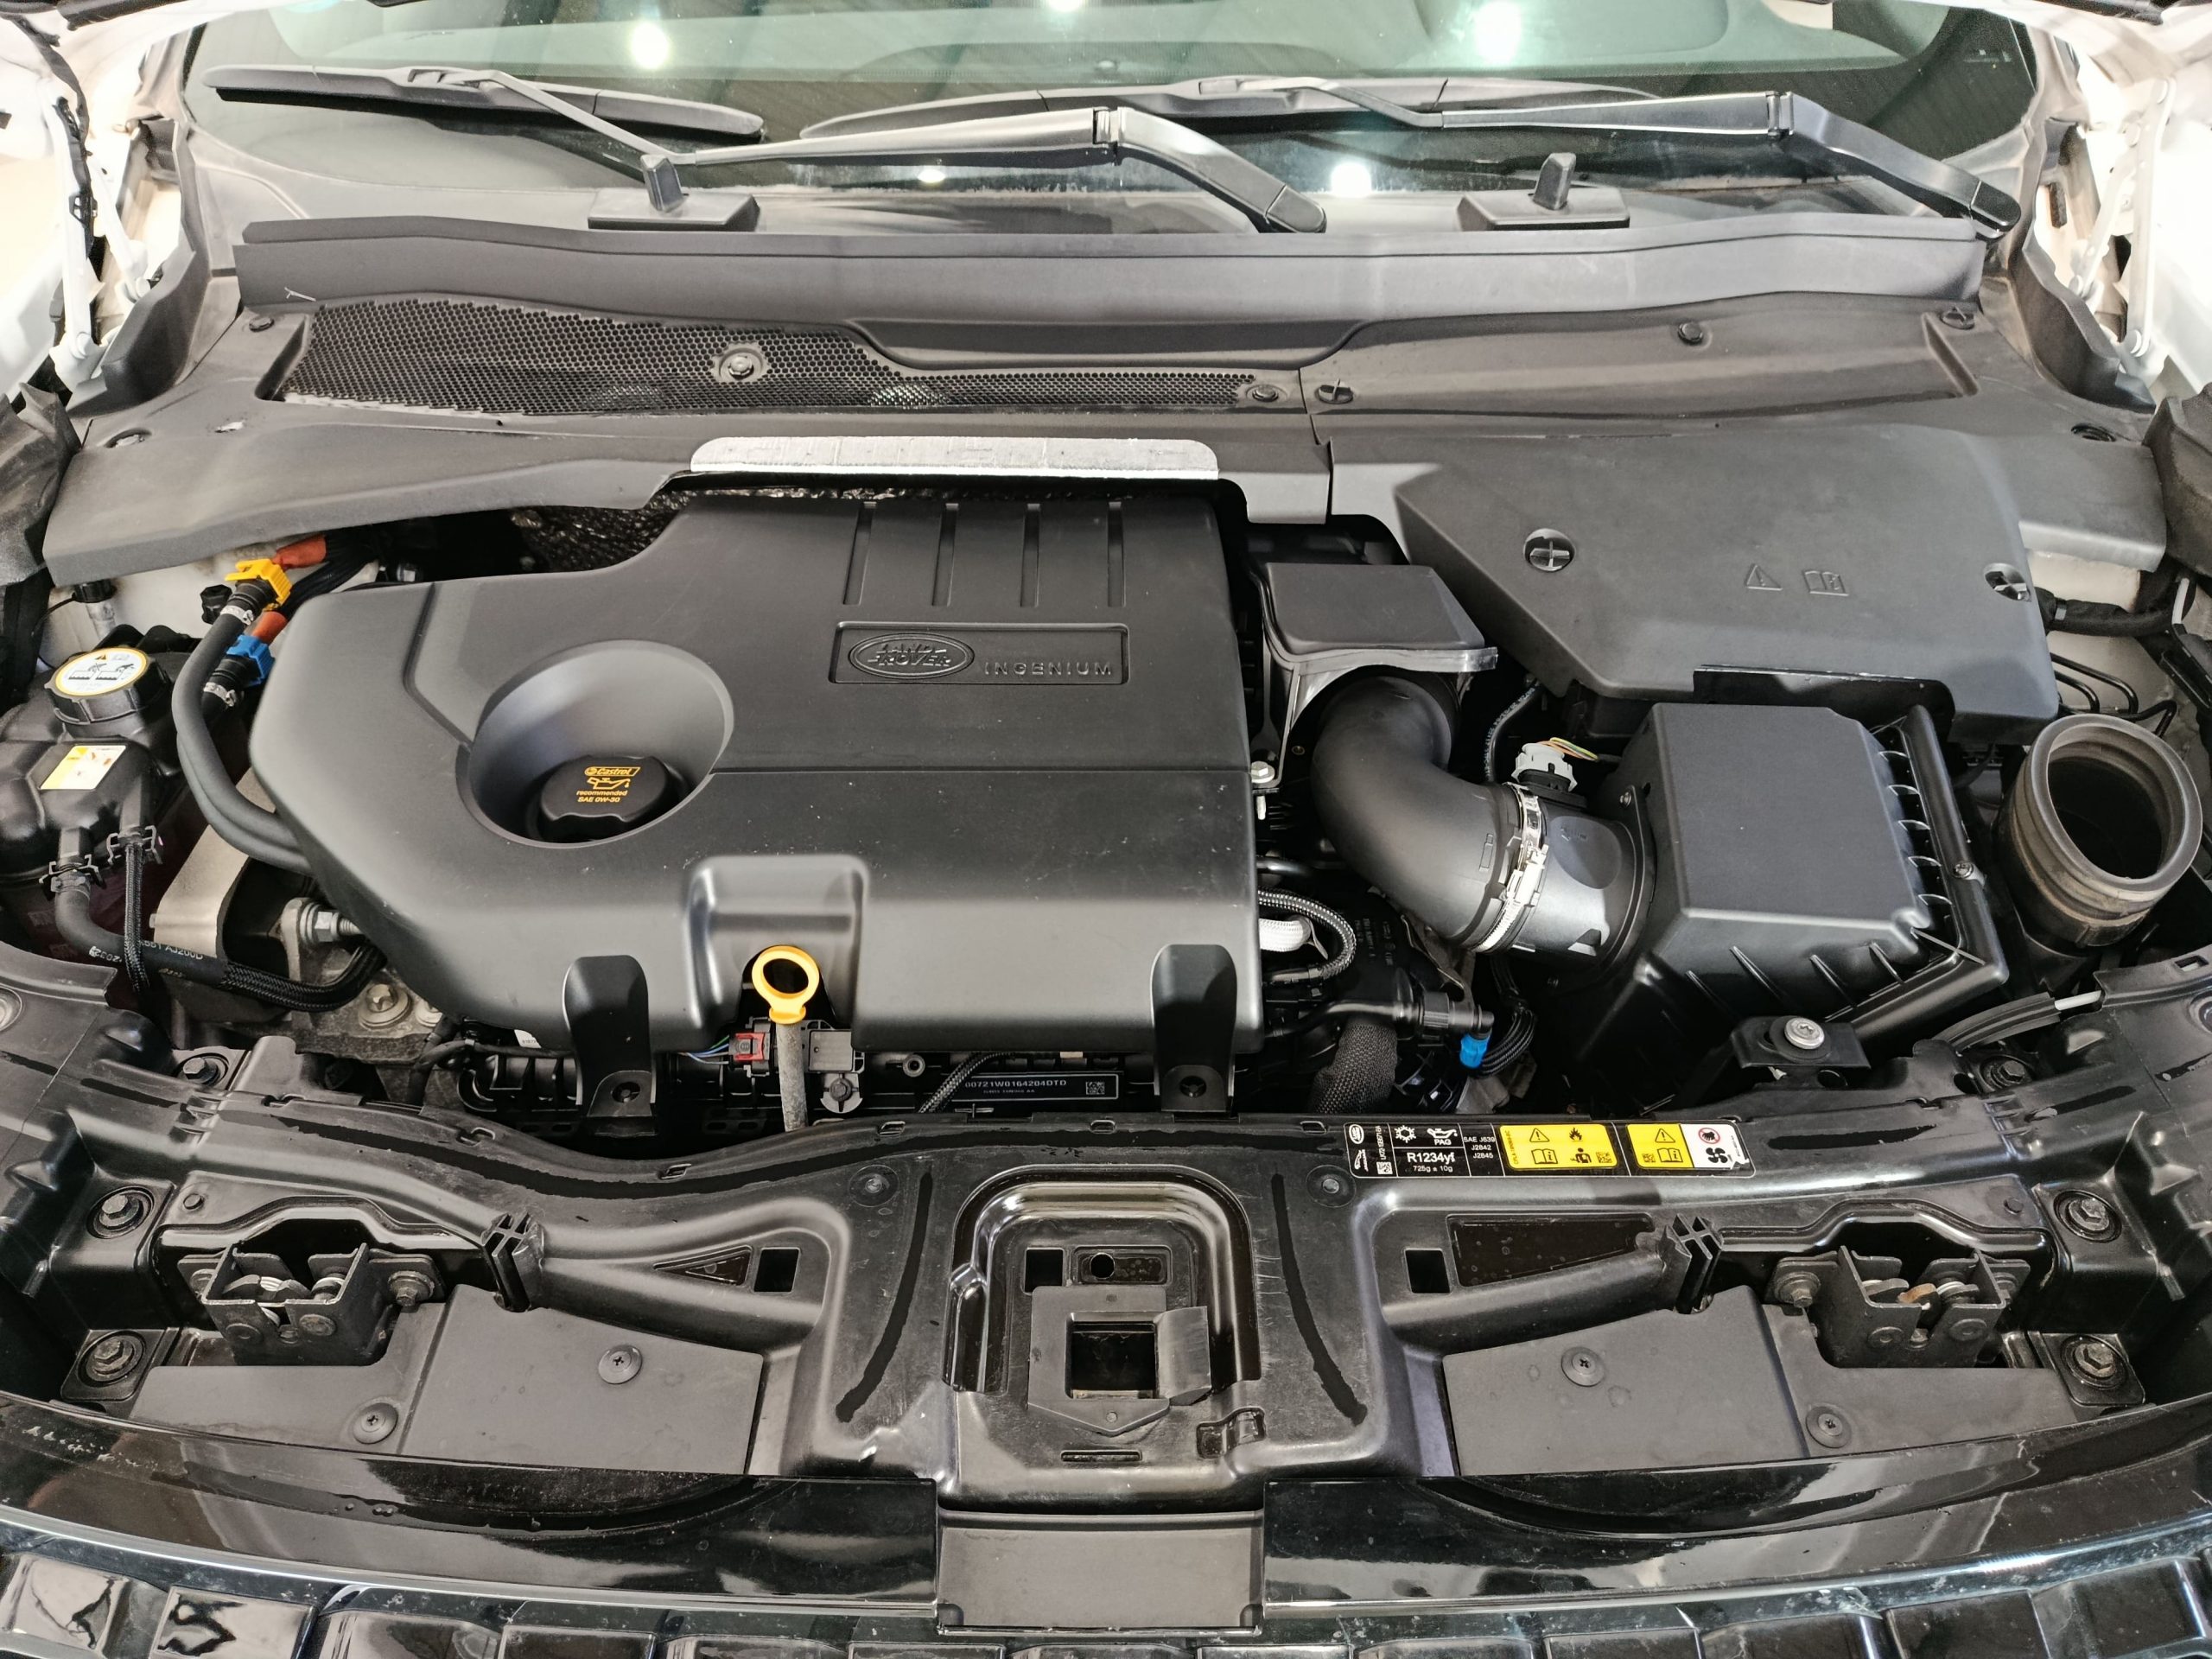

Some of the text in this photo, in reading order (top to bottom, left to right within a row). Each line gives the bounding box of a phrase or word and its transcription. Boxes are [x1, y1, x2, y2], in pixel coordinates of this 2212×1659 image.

[875, 642, 948, 653] LAND
[867, 652, 951, 667] ROVER
[983, 661, 1112, 676] INGENIUM
[1406, 1151, 1456, 1165] R1234yf
[1412, 1165, 1431, 1173] 725g
[1440, 1165, 1453, 1173] 10g
